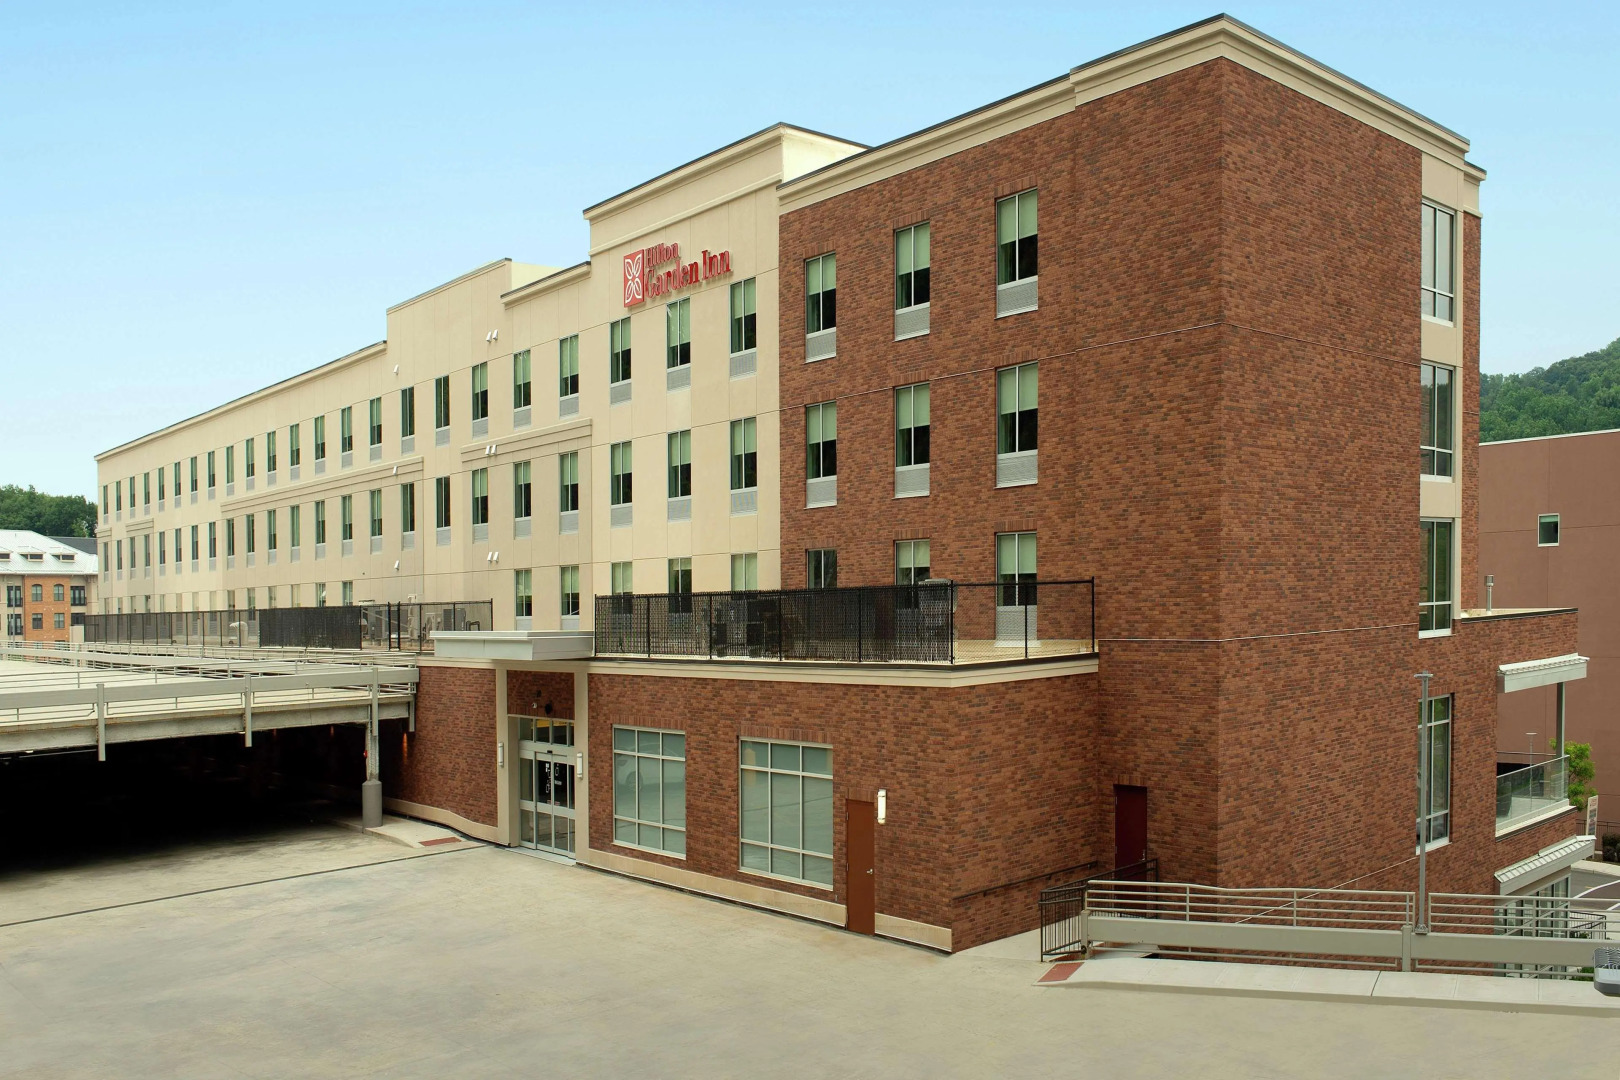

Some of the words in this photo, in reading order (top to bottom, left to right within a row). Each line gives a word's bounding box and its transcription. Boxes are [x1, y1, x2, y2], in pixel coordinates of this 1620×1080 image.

[645, 242, 679, 268] Hilton
[645, 260, 700, 298] Garden
[702, 250, 731, 280] Inn
